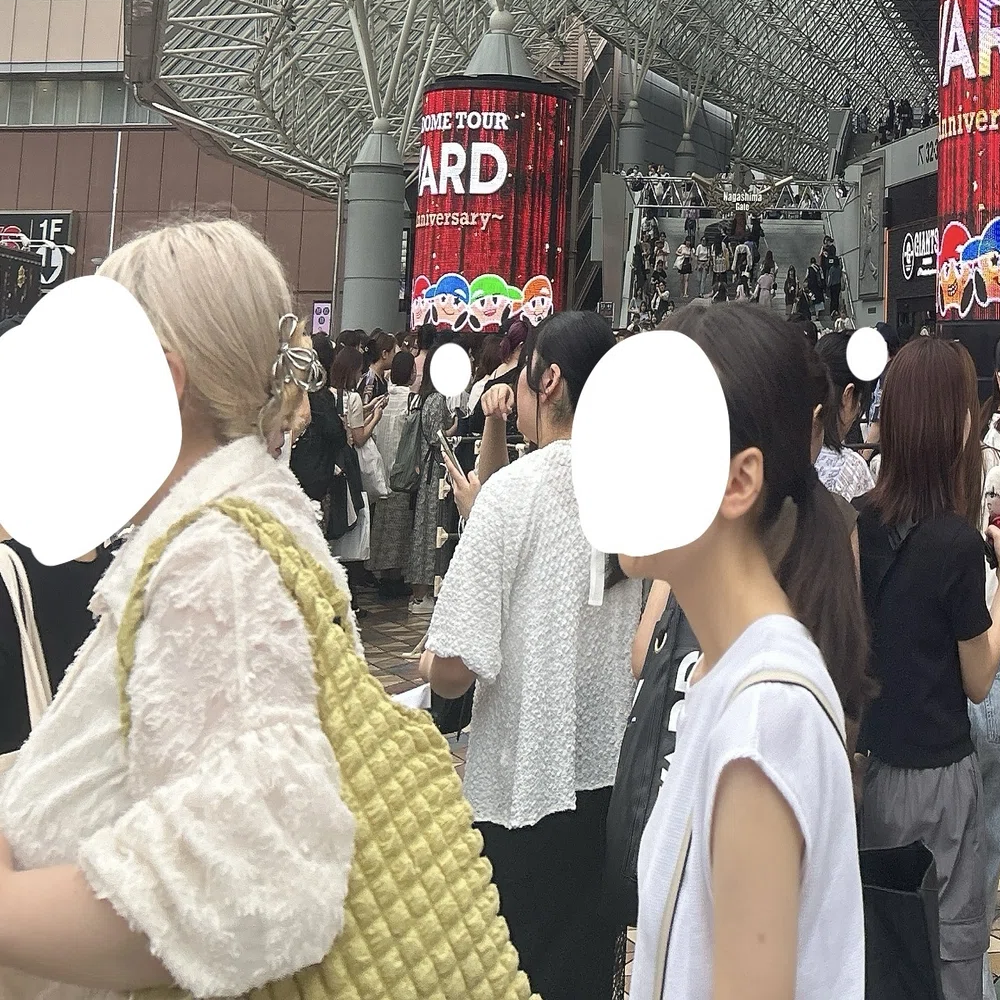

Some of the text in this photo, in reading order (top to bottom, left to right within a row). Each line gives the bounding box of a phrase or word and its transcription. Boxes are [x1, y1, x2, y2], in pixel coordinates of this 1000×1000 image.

[456, 111, 509, 130] TOUR
[418, 142, 508, 197] ARD
[723, 189, 762, 202] Nagashima
[735, 202, 750, 211] Gate
[40, 218, 63, 241] 1F
[416, 209, 504, 231] nniversary~
[914, 228, 939, 257] GIANTS
